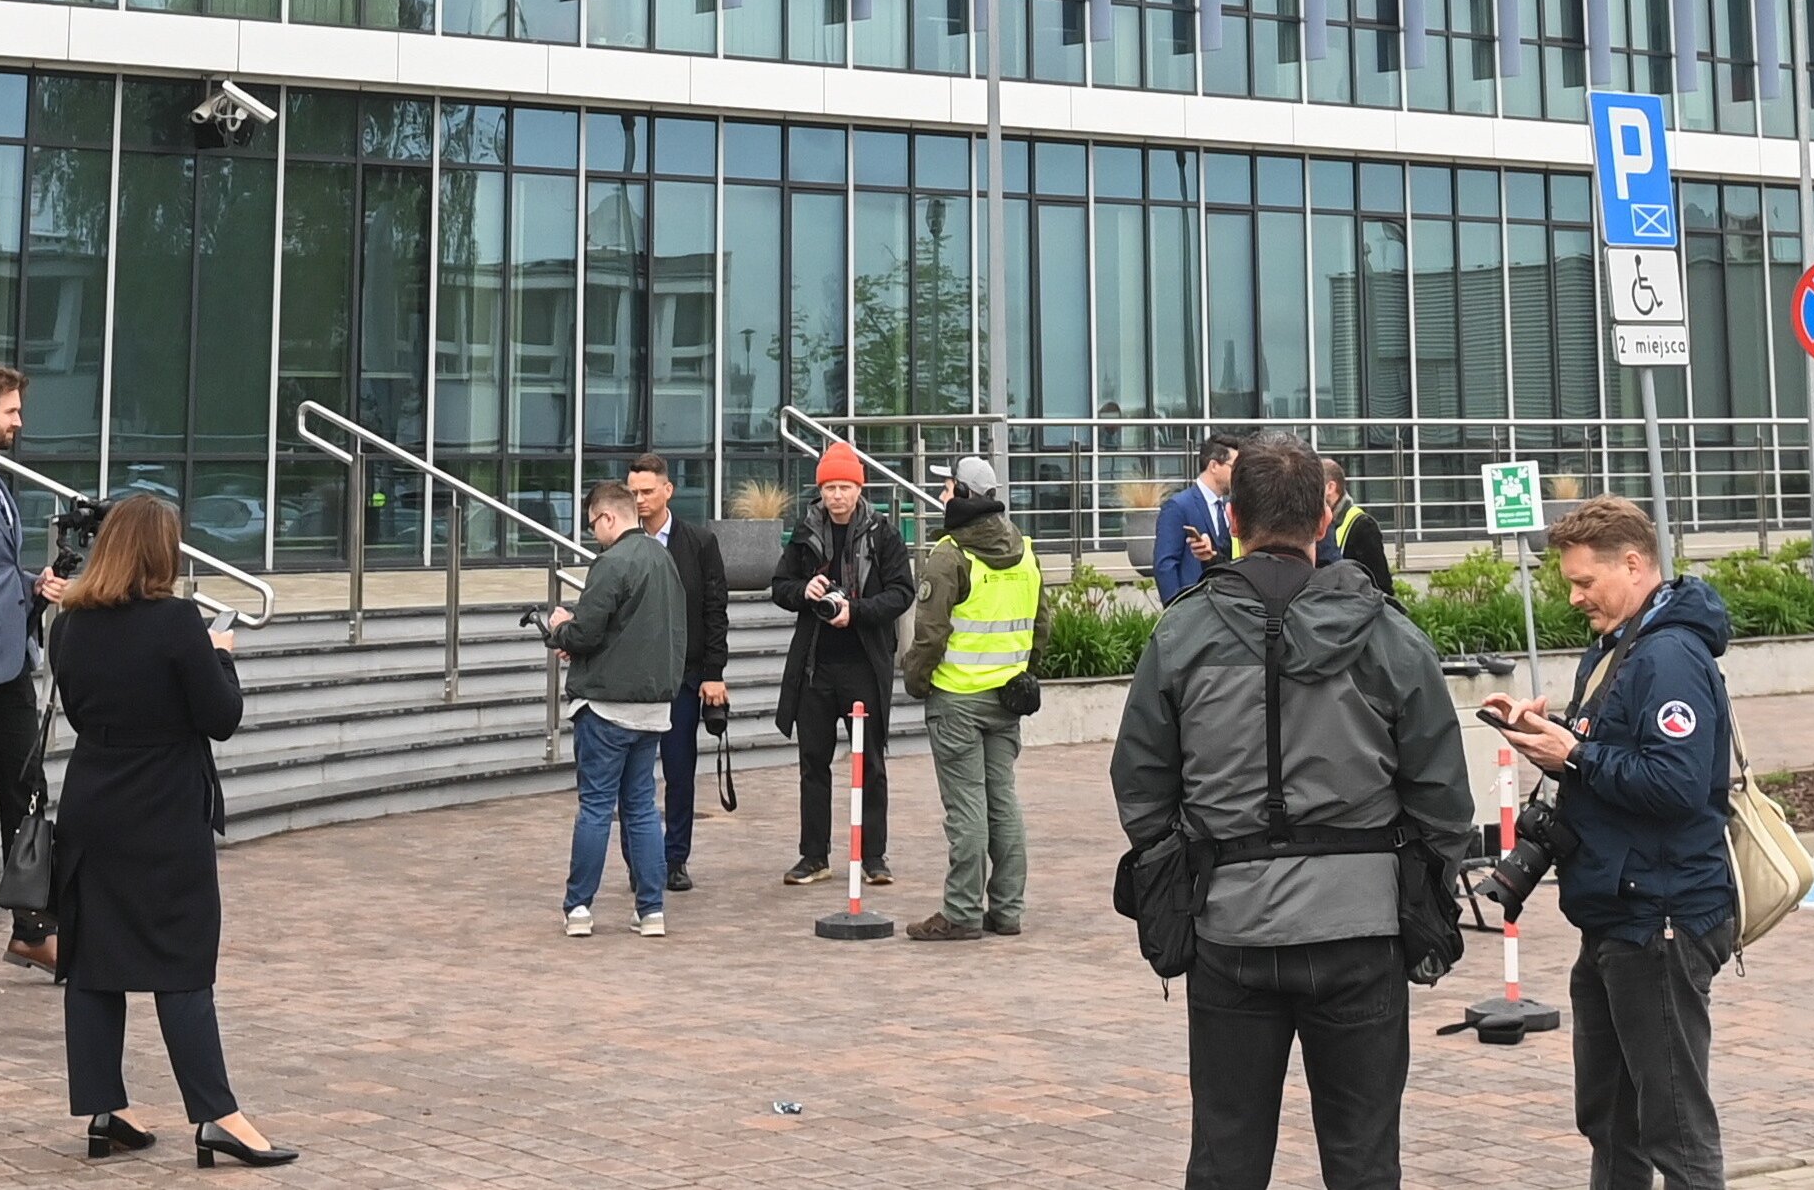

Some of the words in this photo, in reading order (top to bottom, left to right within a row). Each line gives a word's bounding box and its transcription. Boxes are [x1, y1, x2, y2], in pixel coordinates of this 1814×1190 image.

[1608, 106, 1654, 200] P
[1618, 335, 1627, 354] 2
[1635, 334, 1686, 359] miejsca
